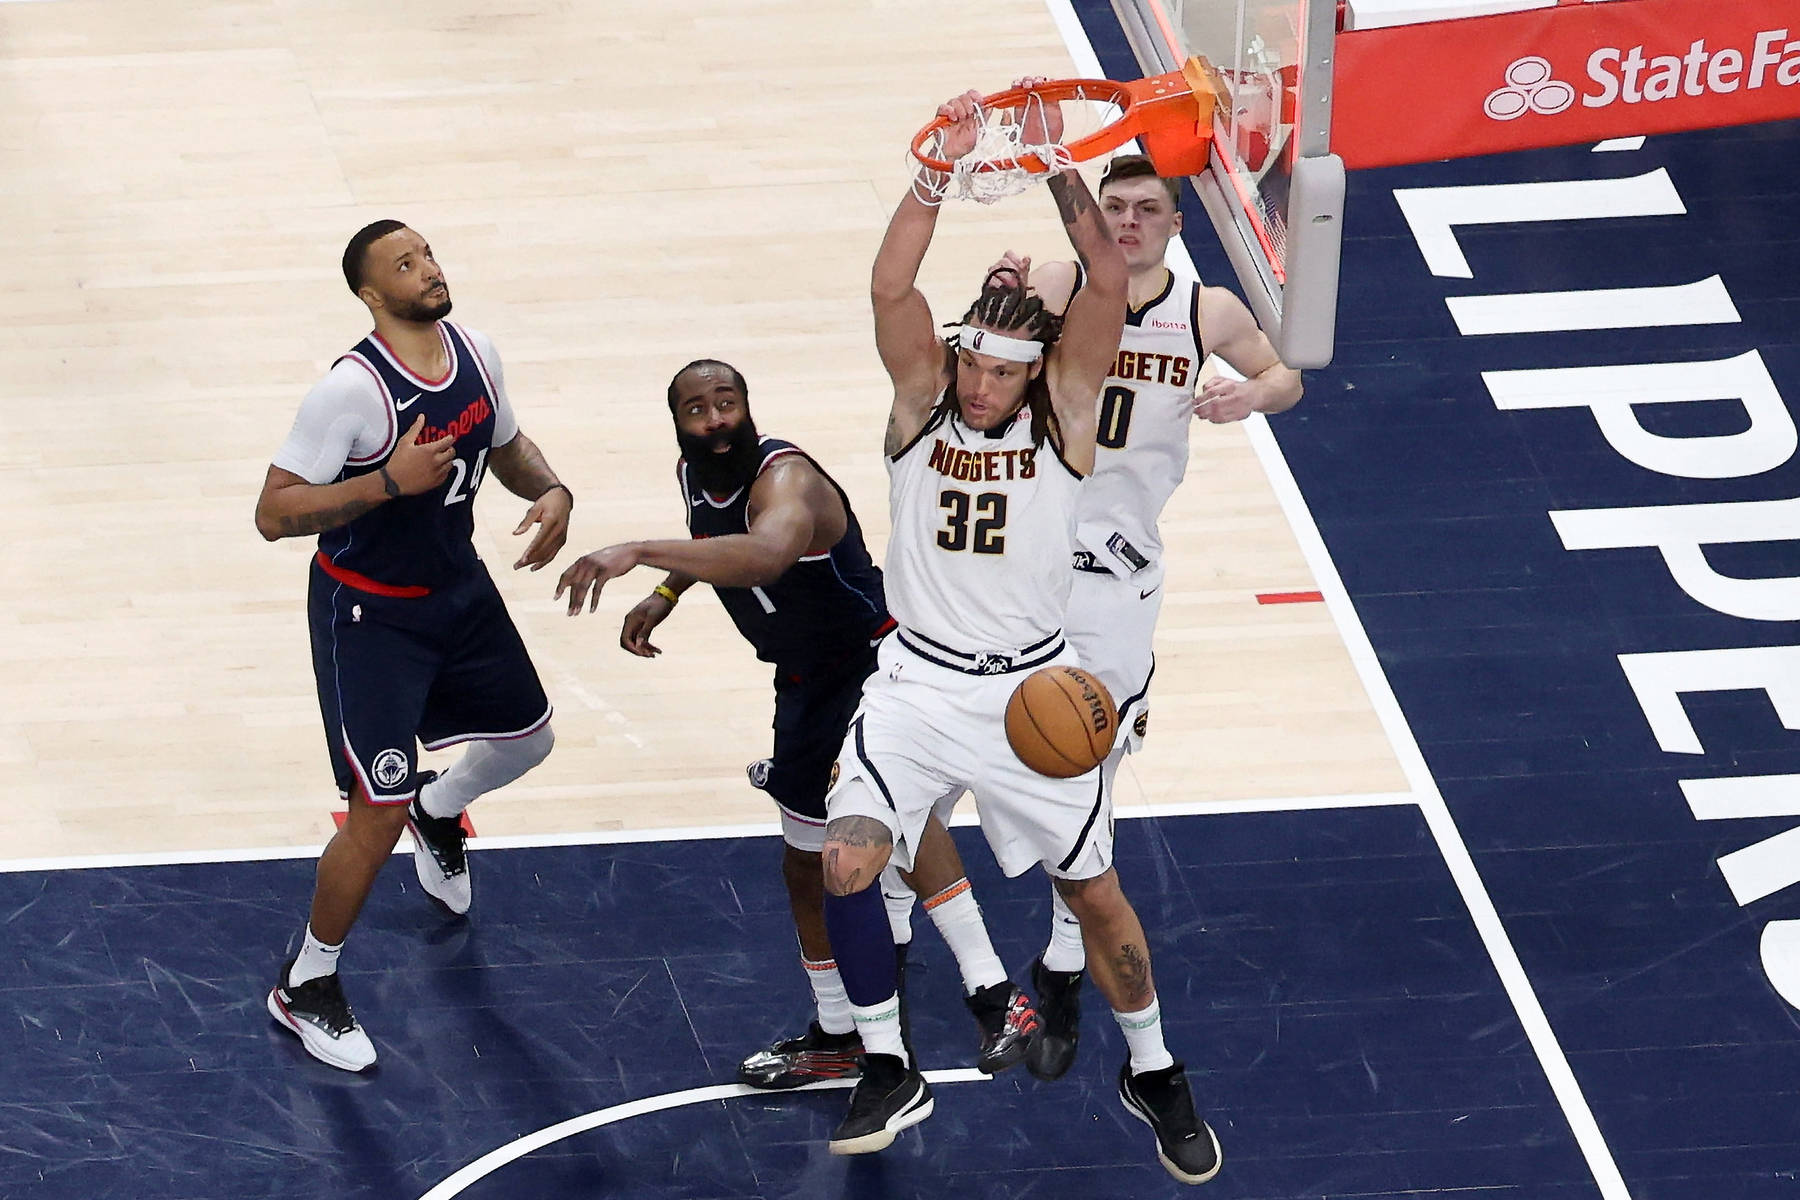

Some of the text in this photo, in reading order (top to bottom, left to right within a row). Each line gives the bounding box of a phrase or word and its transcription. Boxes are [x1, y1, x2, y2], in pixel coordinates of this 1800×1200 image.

[1107, 350, 1191, 387] GETS
[1096, 386, 1136, 449] 0
[936, 489, 1008, 555] 32
[1393, 136, 1800, 1012] LIPPE
[1063, 667, 1108, 735] Wilson
